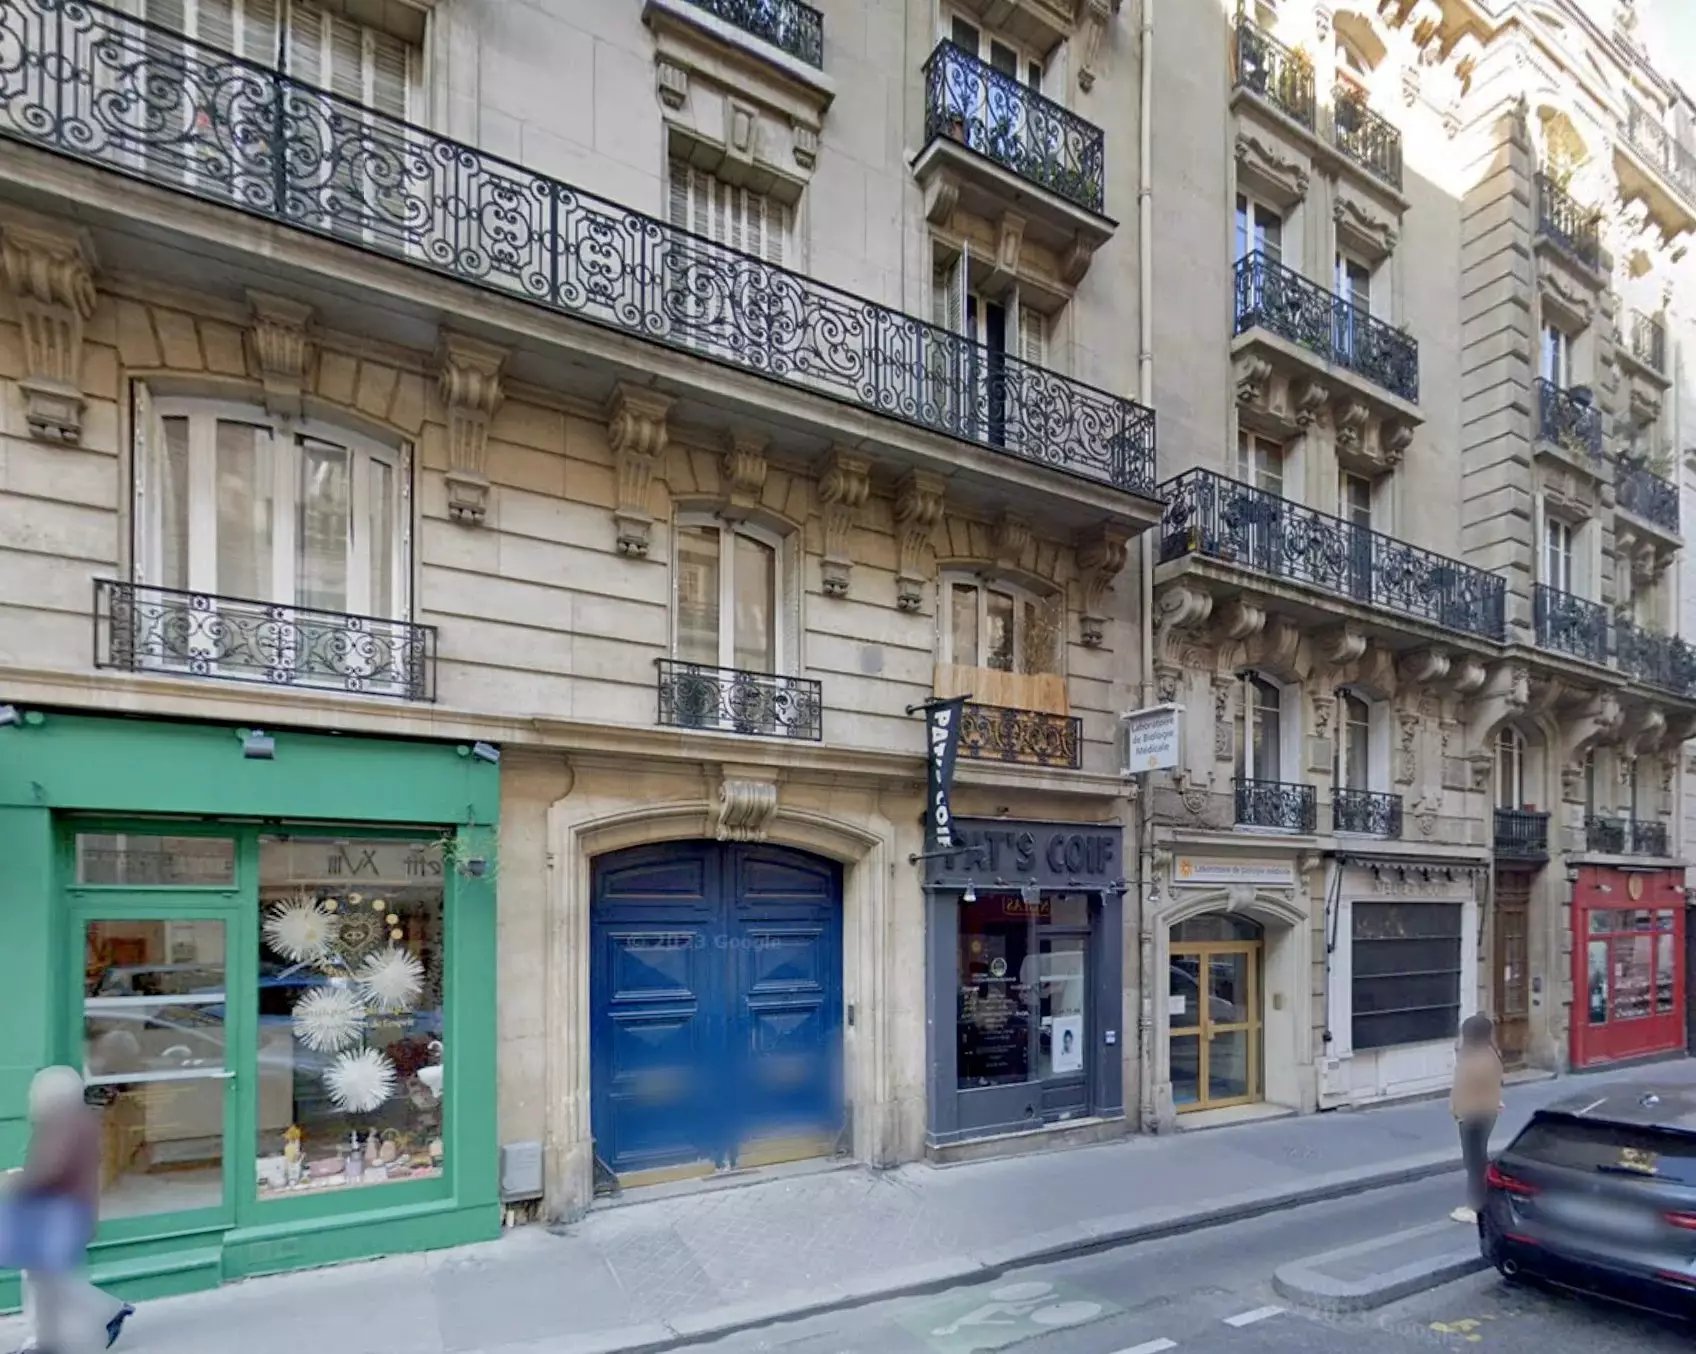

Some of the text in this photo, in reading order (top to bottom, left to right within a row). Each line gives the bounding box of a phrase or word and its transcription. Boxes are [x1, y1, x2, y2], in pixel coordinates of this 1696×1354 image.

[1131, 716, 1174, 733] Laboratoire
[1132, 734, 1142, 745] de
[1136, 742, 1170, 755] Médicale
[1047, 834, 1115, 874] COIF
